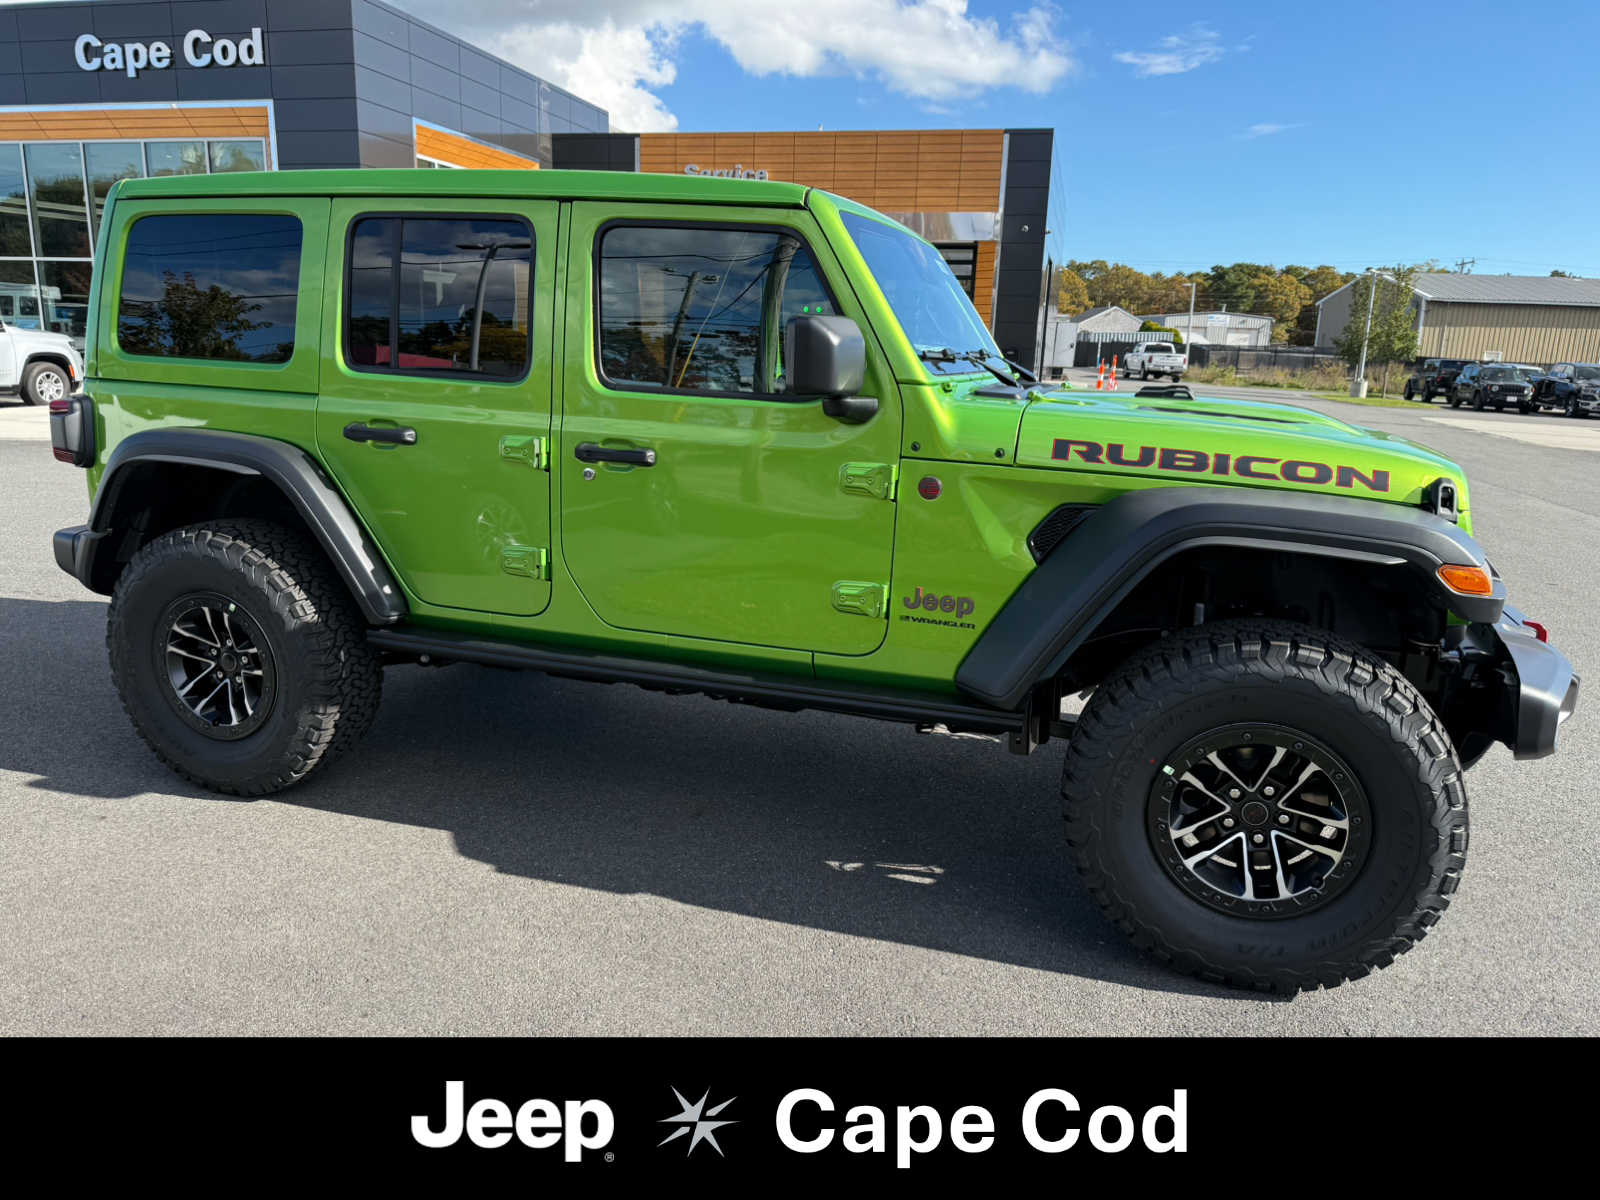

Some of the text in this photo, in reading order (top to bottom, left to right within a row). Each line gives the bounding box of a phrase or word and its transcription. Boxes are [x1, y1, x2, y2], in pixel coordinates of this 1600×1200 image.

[75, 28, 264, 78] Cape Cod
[1051, 438, 1390, 492] RUBICON
[904, 586, 975, 618] Jeep
